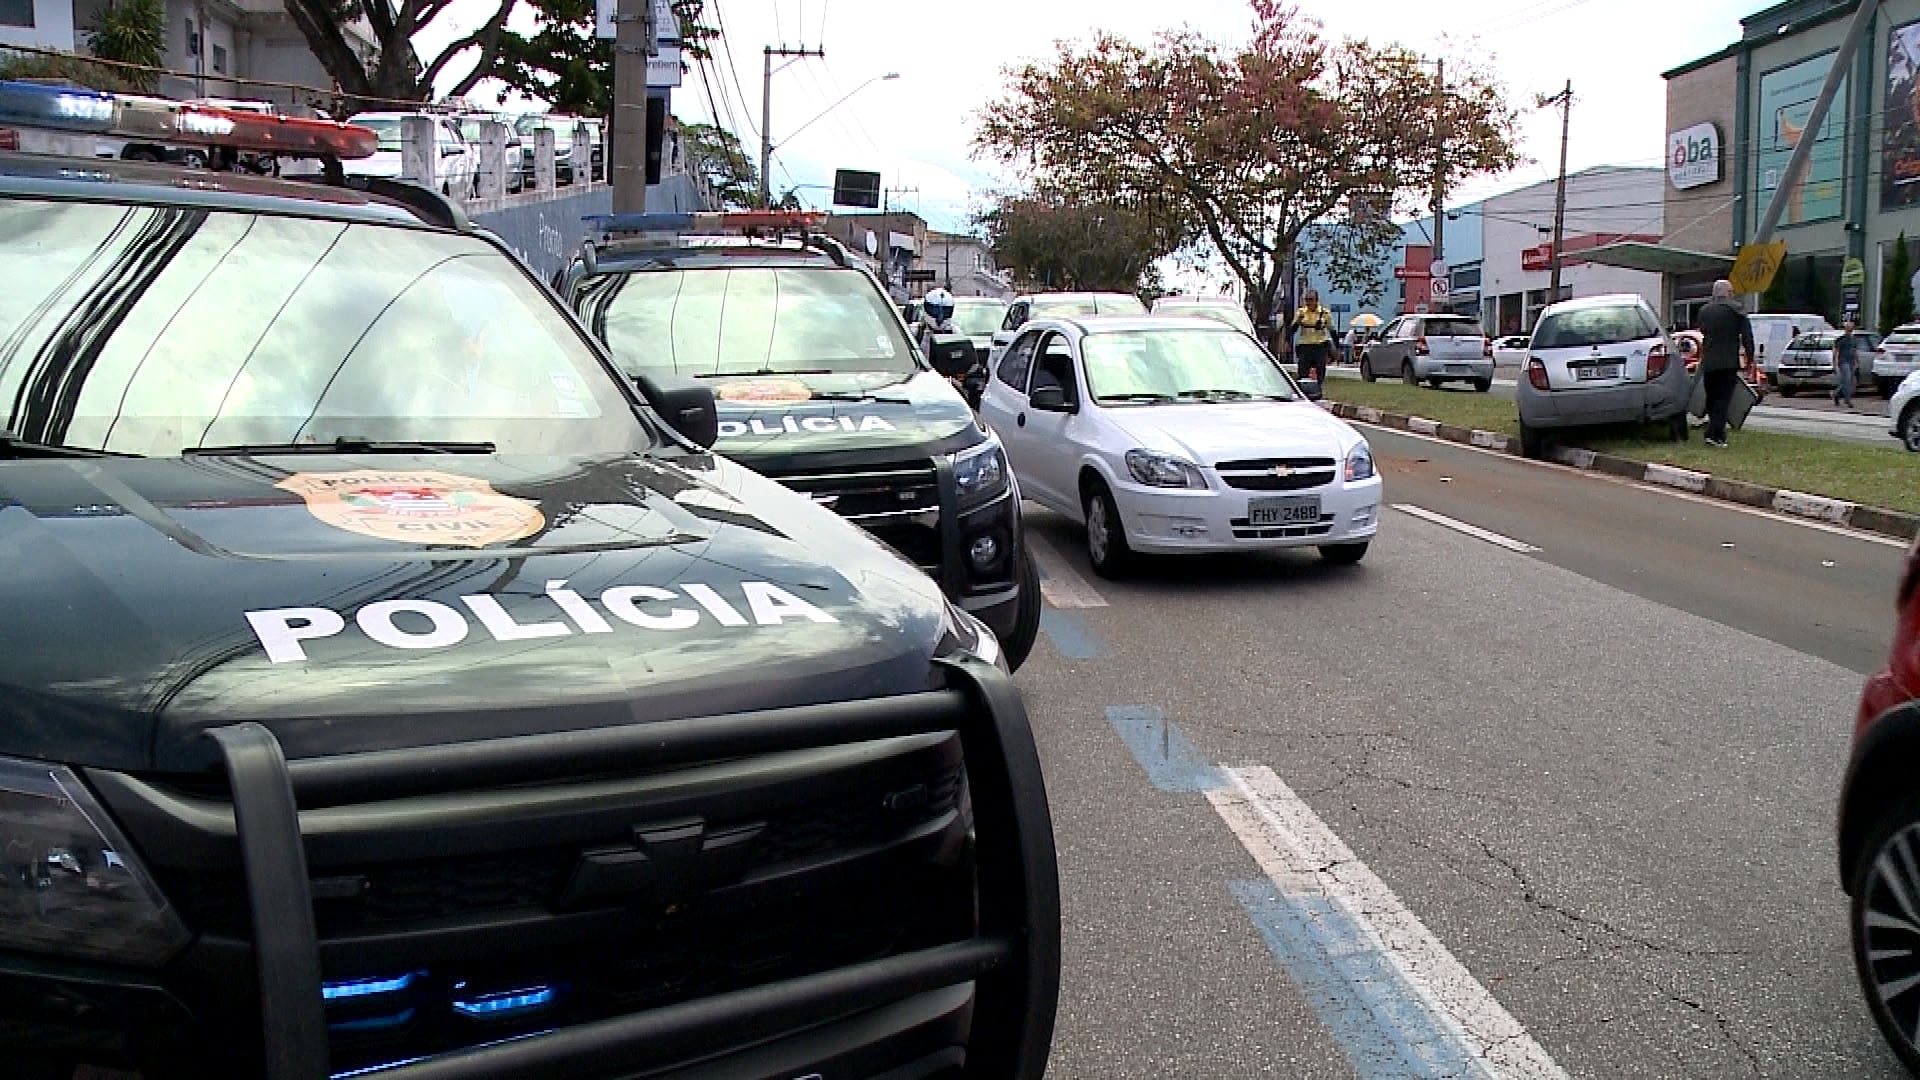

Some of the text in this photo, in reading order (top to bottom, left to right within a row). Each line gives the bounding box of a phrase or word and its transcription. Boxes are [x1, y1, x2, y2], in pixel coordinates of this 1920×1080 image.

[539, 211, 563, 258] Pronto
[718, 415, 897, 437] OLÍCIA
[1253, 508, 1278, 522] FHY
[244, 579, 841, 664] POLÍCIA
